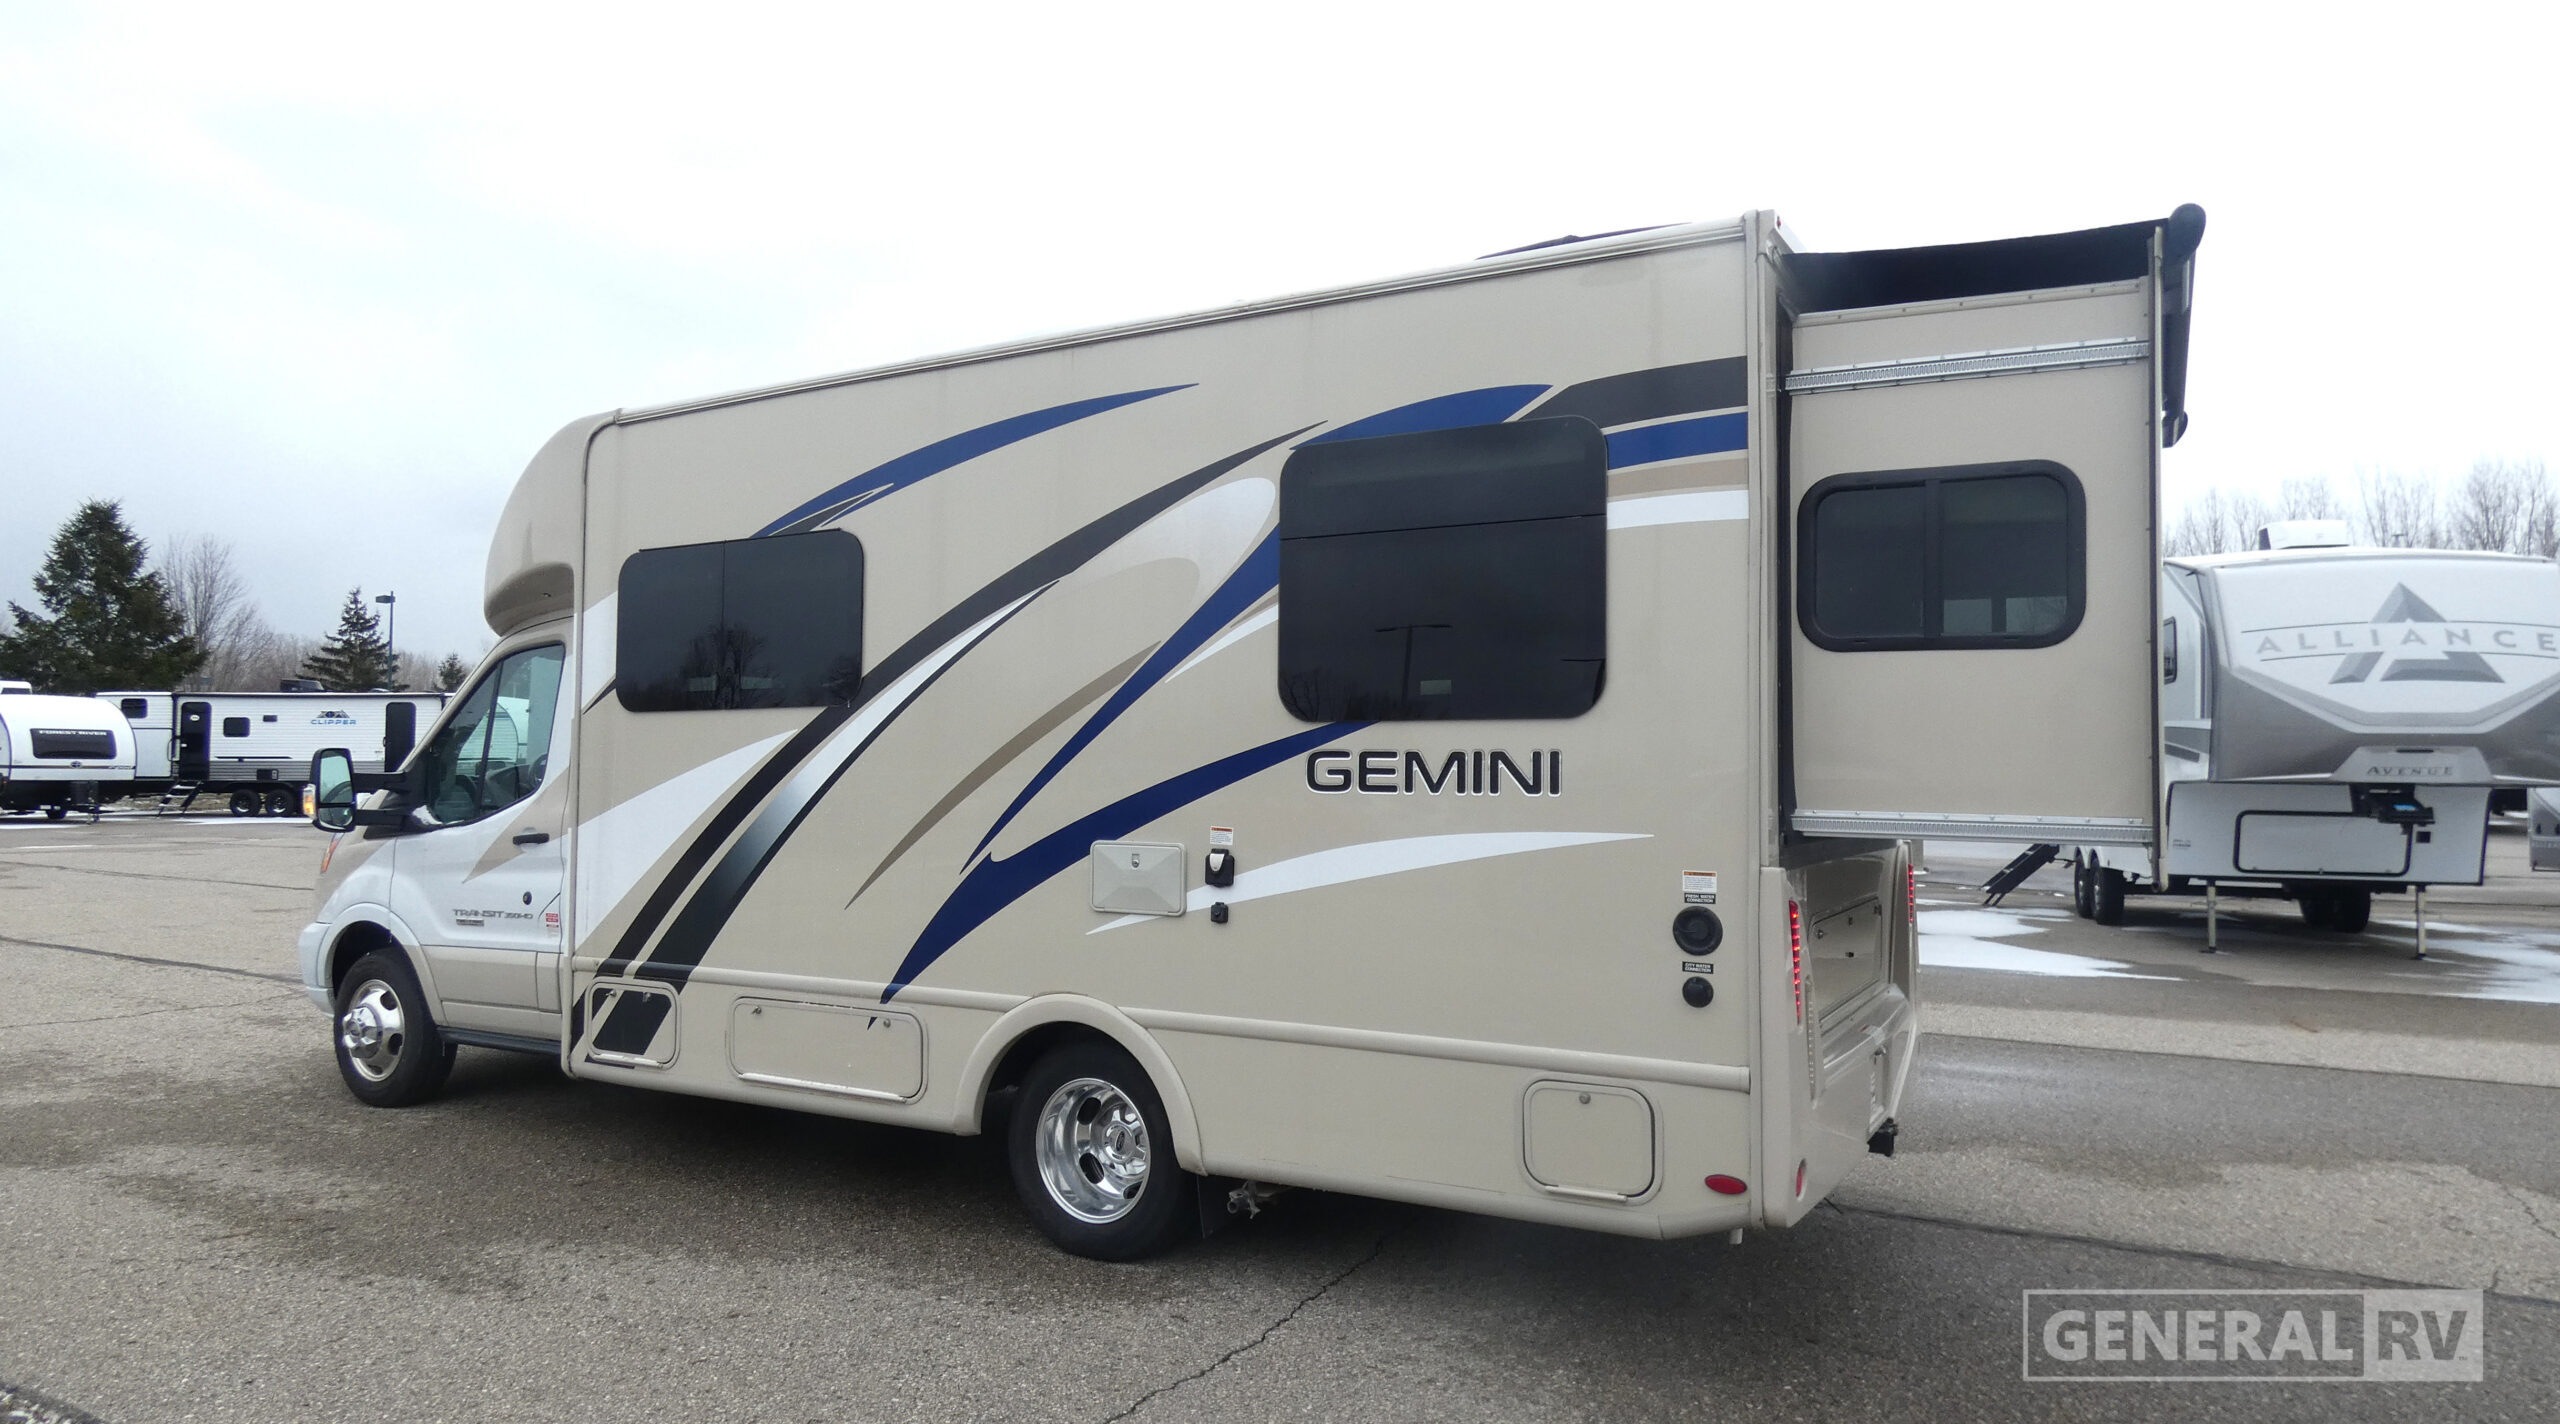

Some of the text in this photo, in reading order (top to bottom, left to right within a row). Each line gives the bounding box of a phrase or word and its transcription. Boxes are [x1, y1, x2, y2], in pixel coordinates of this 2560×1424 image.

[2256, 628, 2557, 654] ALLIANCE
[1306, 750, 1562, 796] GEMINI
[2366, 766, 2454, 777] AVENUE
[452, 908, 504, 918] TRANSIT
